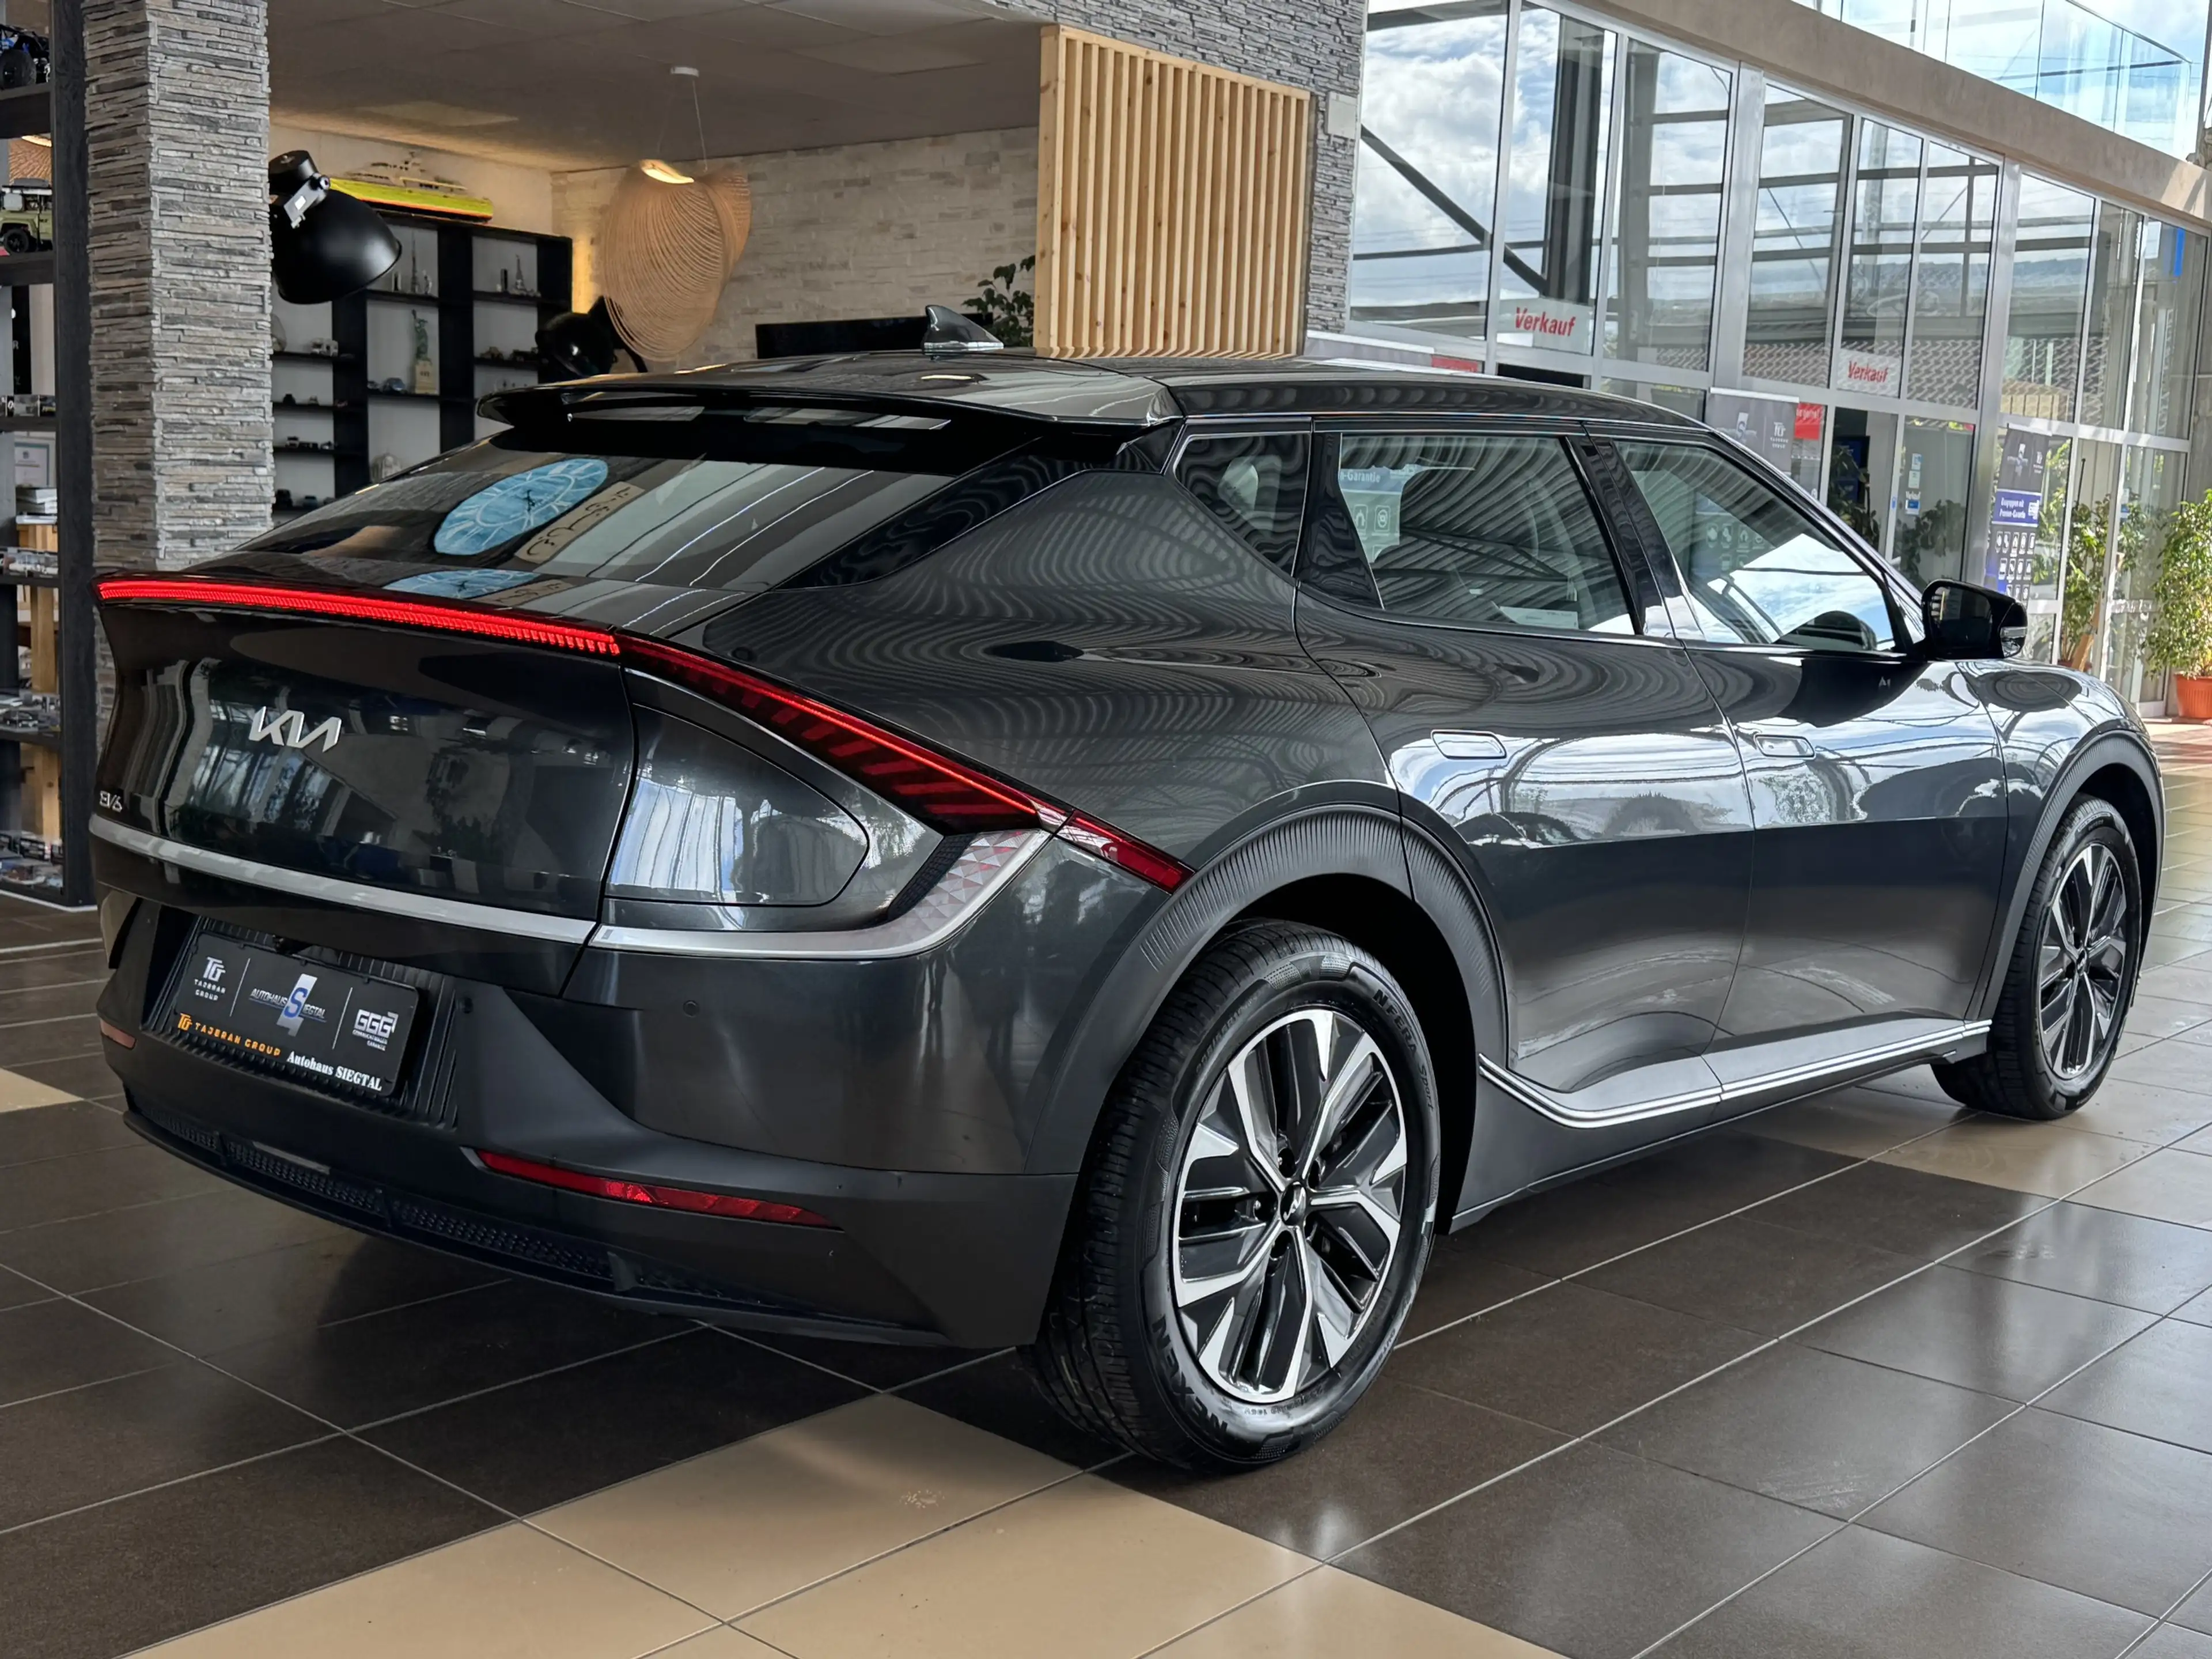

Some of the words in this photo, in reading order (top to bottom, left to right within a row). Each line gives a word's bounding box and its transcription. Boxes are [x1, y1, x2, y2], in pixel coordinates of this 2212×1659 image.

[1515, 306, 1576, 336] Verkauf
[1848, 361, 1888, 382] Verkauf
[249, 706, 342, 753] KIA
[244, 1038, 281, 1056] GROUP
[286, 1050, 334, 1076] Autohaus
[335, 1065, 382, 1091] SIEGTAL
[1150, 1312, 1229, 1442] NEXEN
